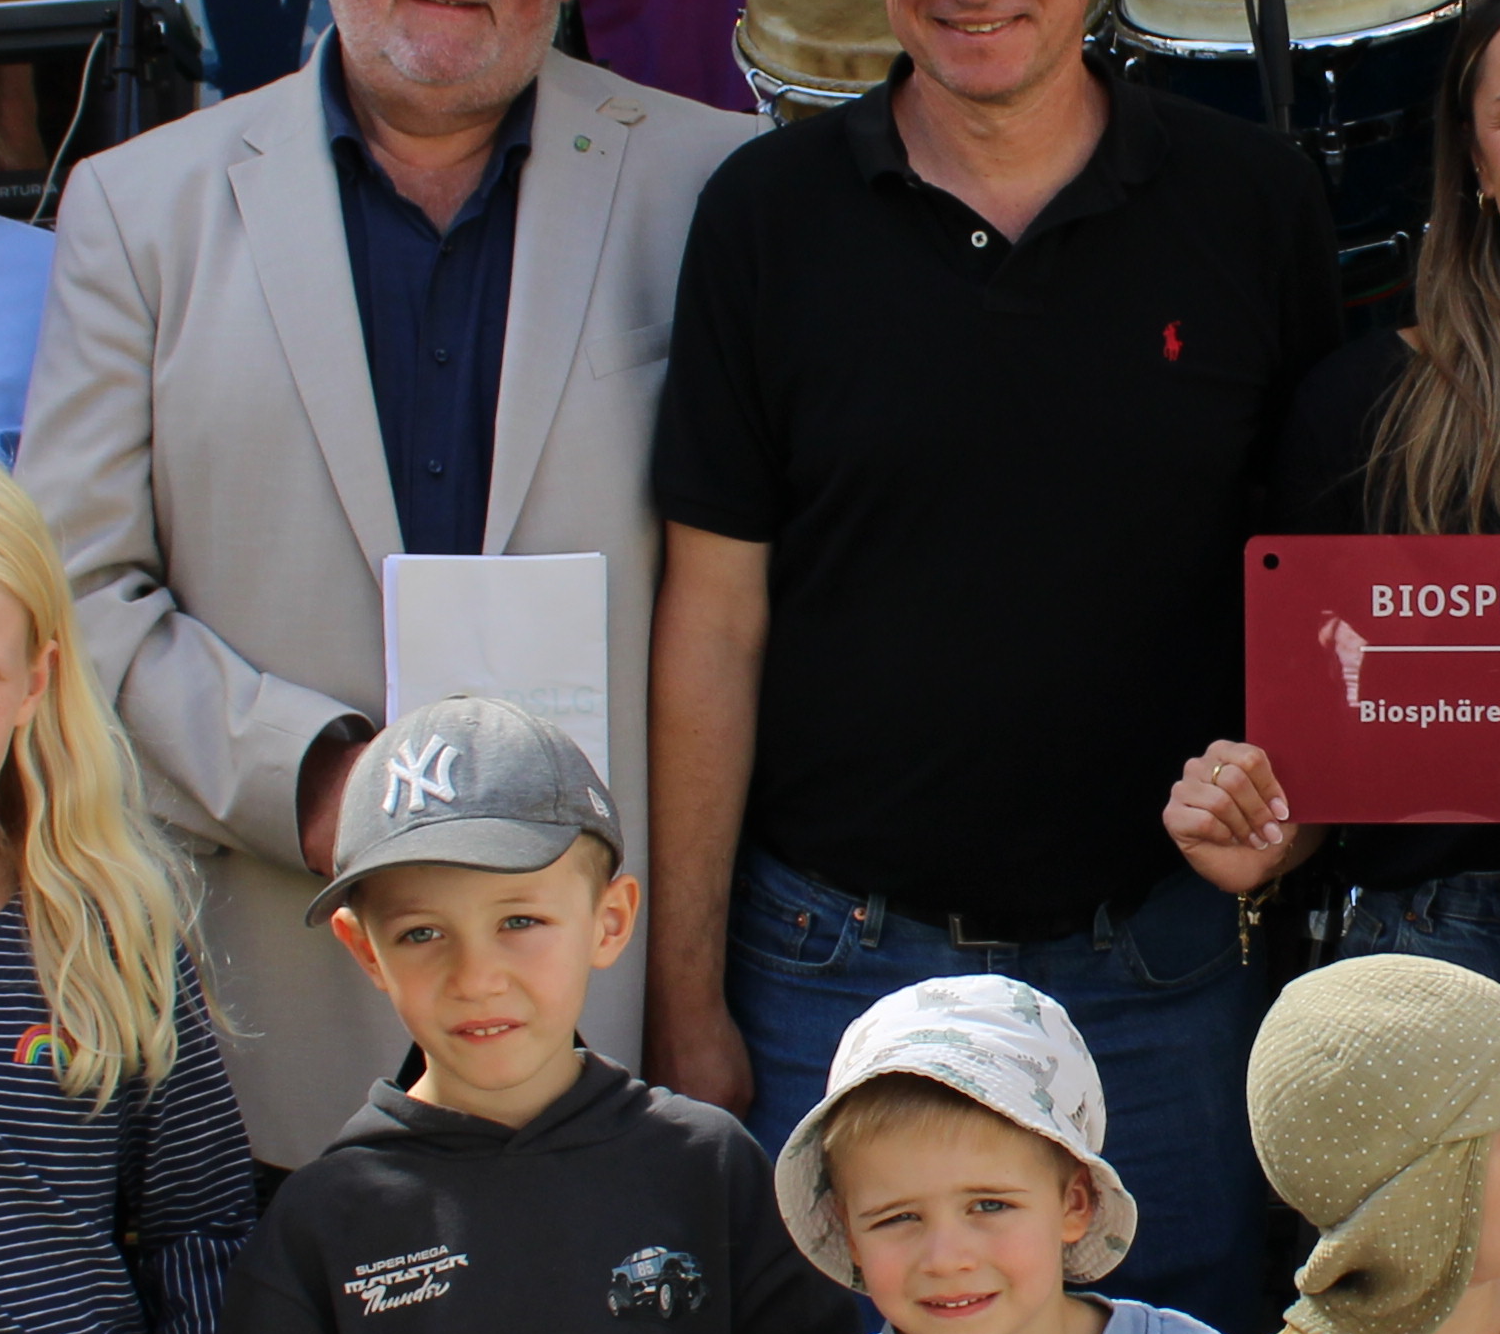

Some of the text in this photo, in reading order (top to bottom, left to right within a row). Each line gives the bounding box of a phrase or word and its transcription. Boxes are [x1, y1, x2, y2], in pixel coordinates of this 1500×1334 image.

[381, 733, 461, 816] NY
[355, 1244, 449, 1276] SUPER MEGA
[360, 1273, 451, 1317] Thunder
